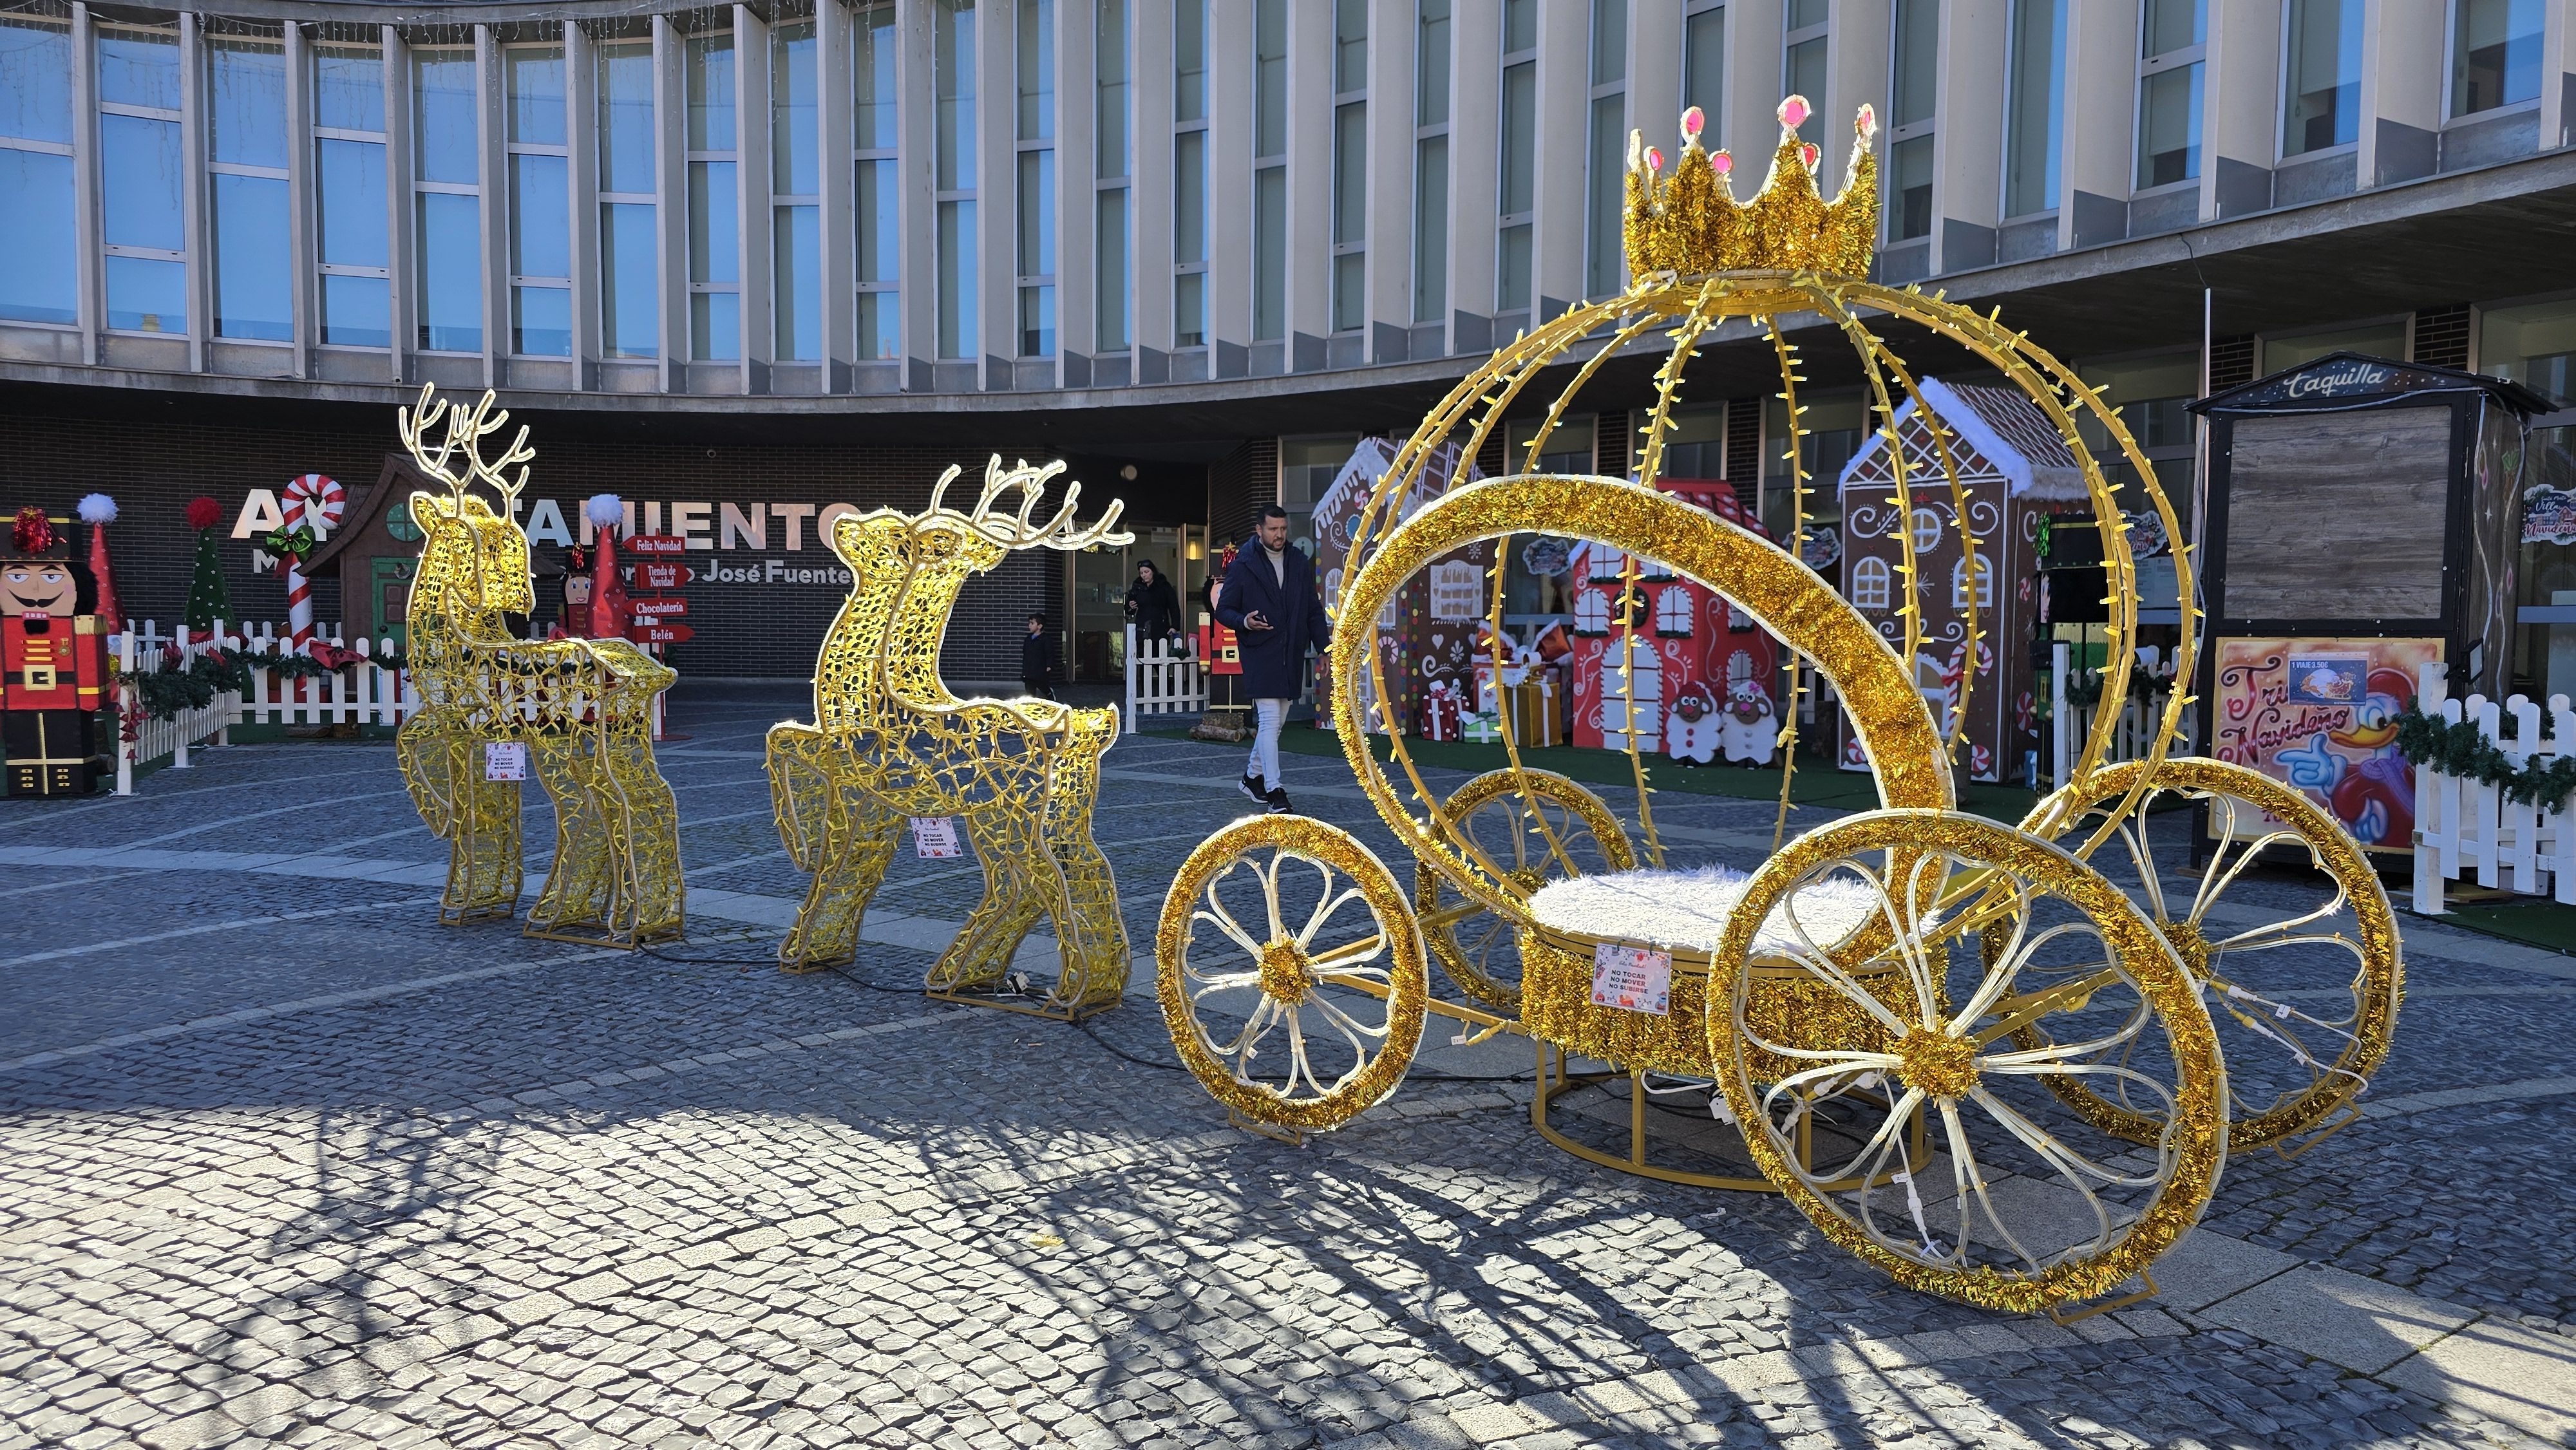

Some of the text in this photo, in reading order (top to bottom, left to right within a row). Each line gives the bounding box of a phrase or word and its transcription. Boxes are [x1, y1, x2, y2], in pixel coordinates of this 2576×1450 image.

[2535, 501, 2559, 512] Villa
[230, 488, 862, 552] AYAMIENTO
[636, 540, 682, 551] Feliz Navidad
[647, 565, 668, 576] Tienda
[668, 565, 676, 576] de
[703, 559, 760, 583] José
[766, 560, 854, 584] Fuente
[650, 577, 674, 587] Navidad
[636, 601, 684, 614] Chocolatería
[650, 629, 674, 640] Belén
[2217, 706, 2350, 765] Navideño
[1623, 971, 1646, 979] TOCAR
[1622, 978, 1646, 987] MOVER
[1620, 985, 1649, 994] SUBIRSE
